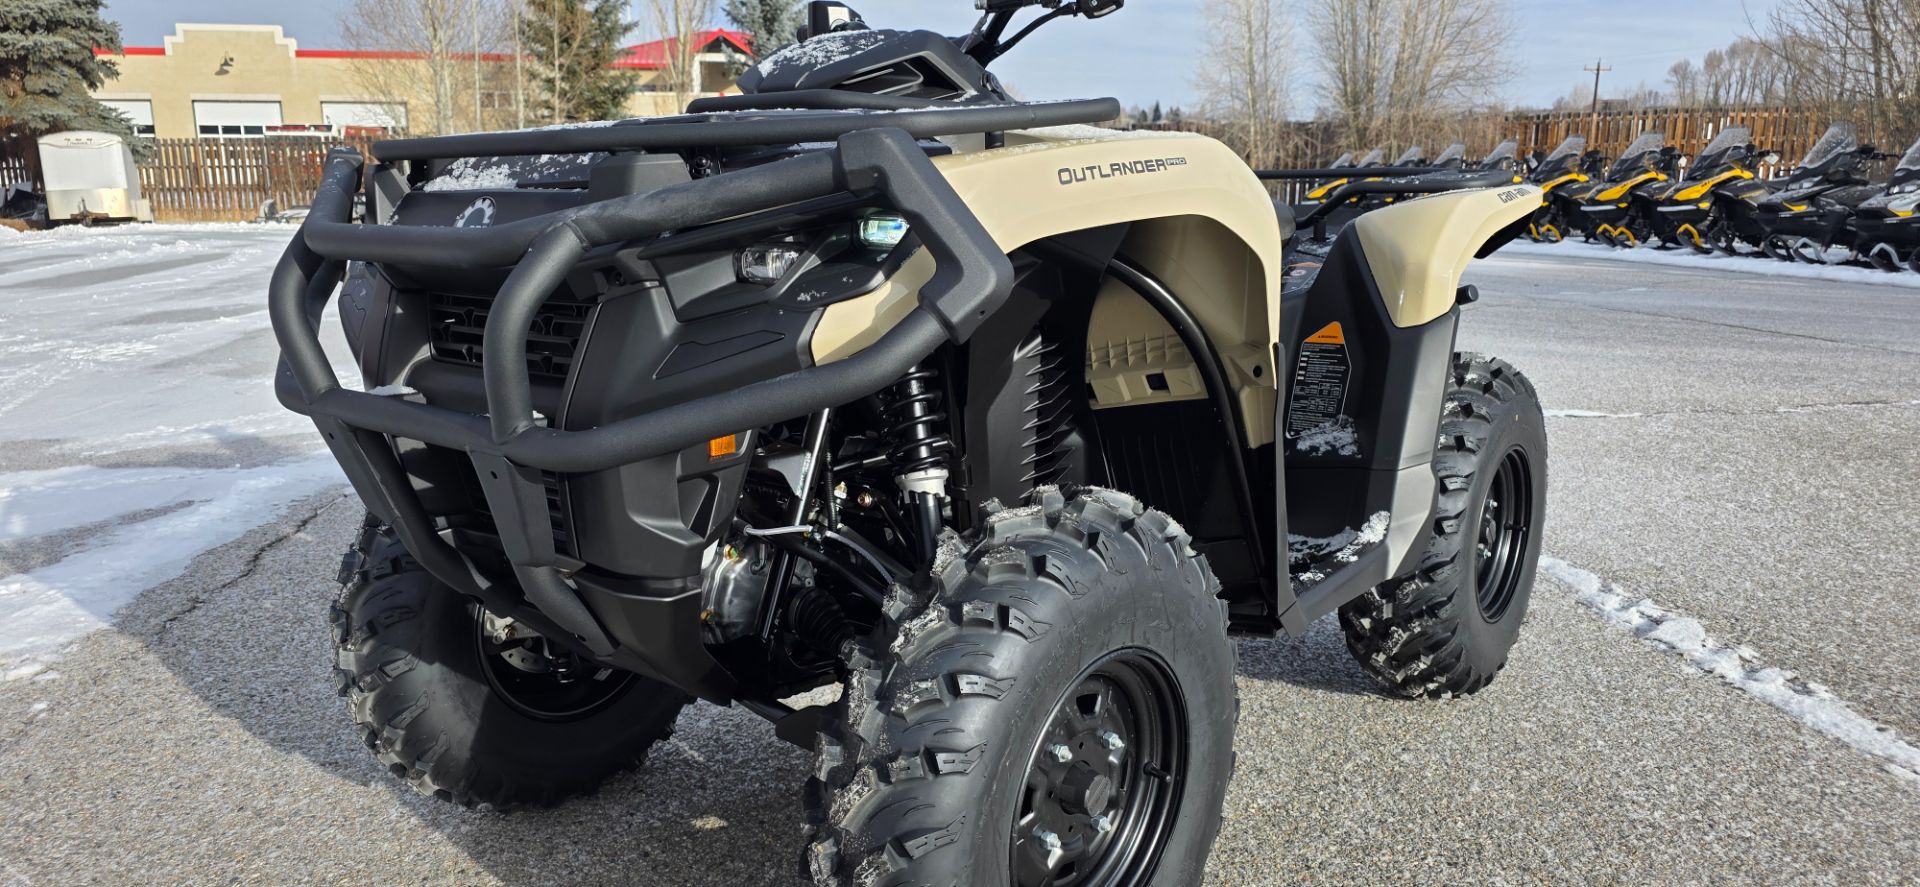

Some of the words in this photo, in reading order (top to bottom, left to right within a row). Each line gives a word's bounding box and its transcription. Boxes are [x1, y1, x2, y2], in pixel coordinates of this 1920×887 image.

[1057, 159, 1167, 185] OUTLANDER
[1166, 157, 1187, 166] PRO
[1497, 188, 1531, 203] can-am
